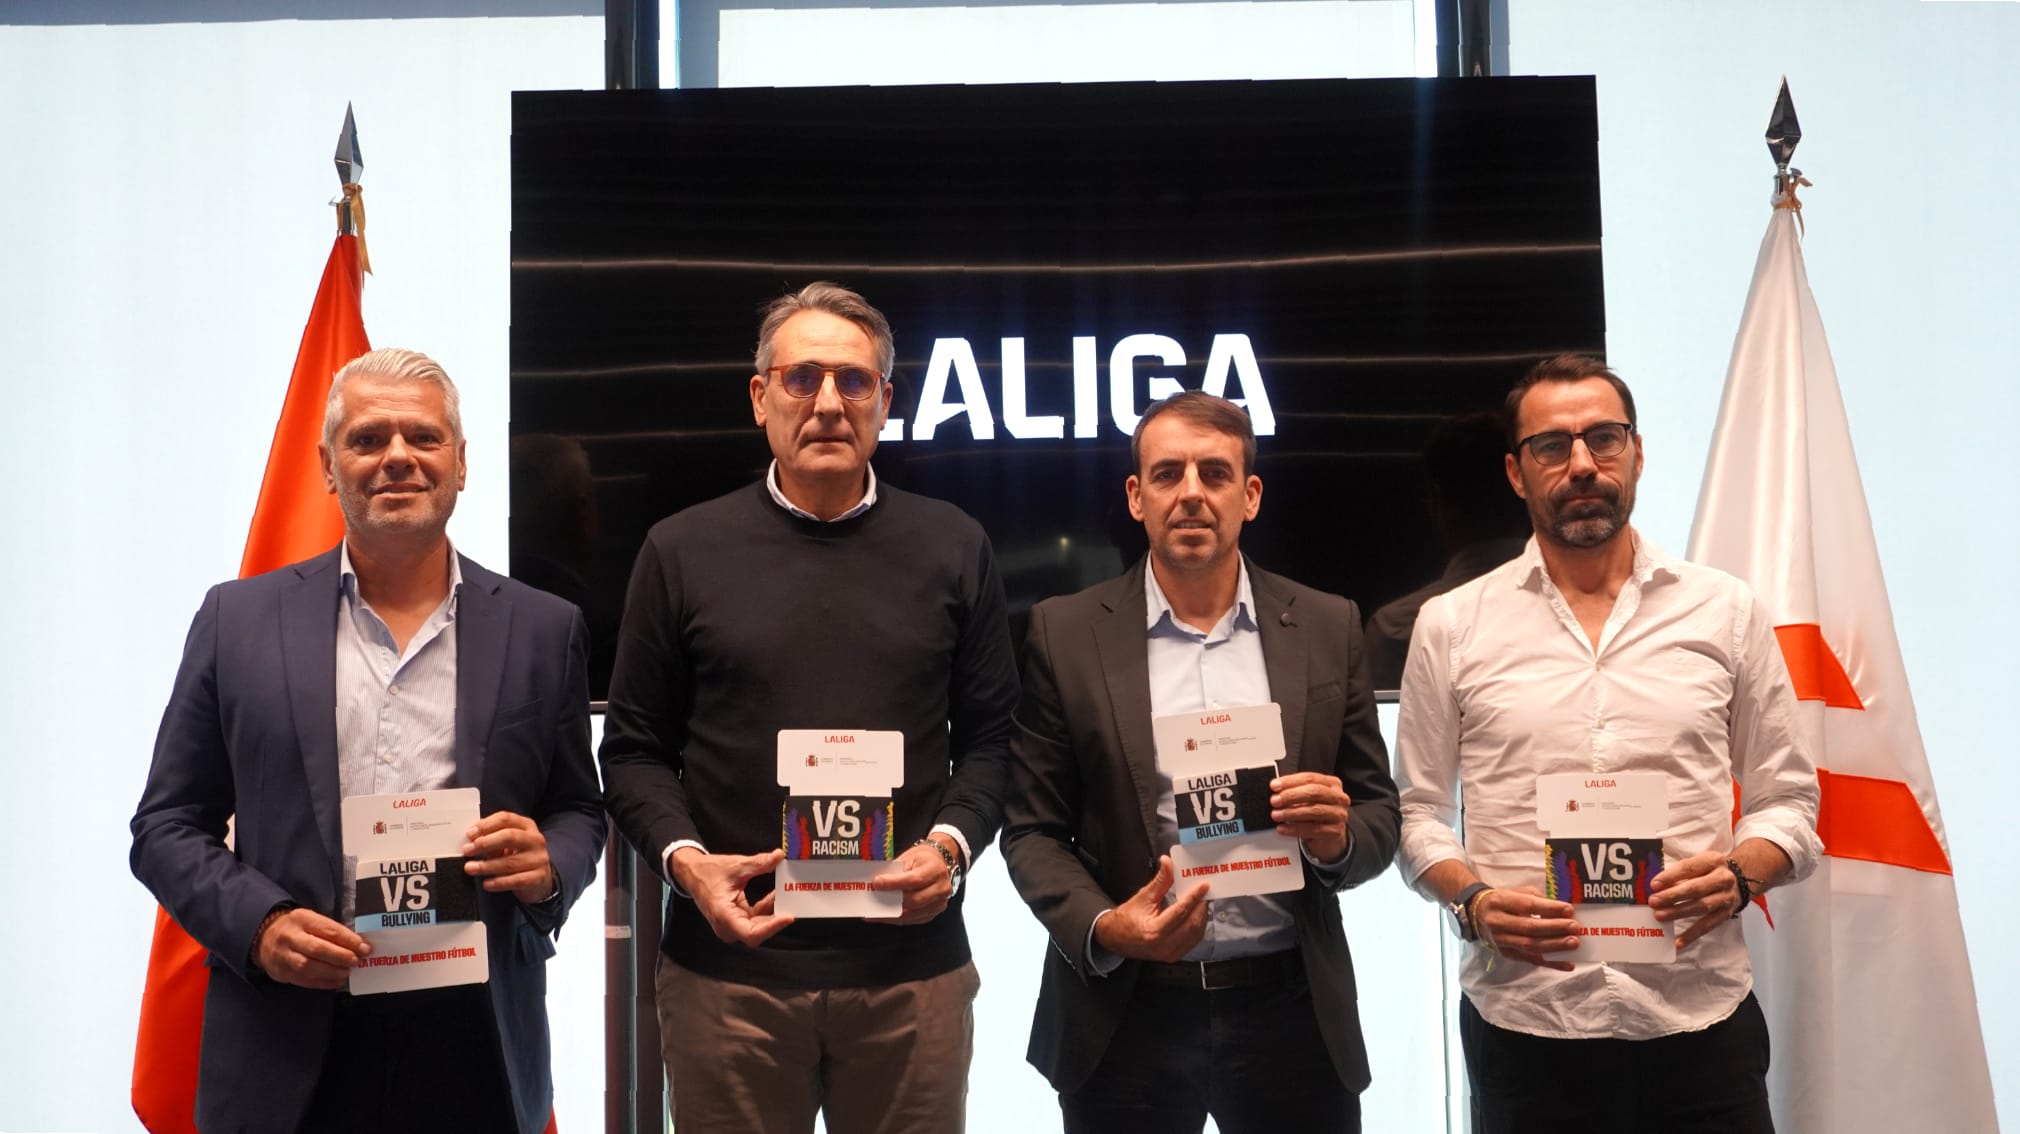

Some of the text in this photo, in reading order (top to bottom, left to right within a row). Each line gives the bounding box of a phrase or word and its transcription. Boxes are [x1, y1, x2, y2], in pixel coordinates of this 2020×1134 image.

[1200, 714, 1231, 725] LALIGA
[824, 735, 855, 743] LALIGA
[1188, 773, 1232, 791] LALIGA
[1584, 780, 1617, 788] LALIGA
[392, 798, 426, 809] LALIGA
[1189, 787, 1236, 825] VS
[812, 799, 860, 838] VS
[1195, 821, 1239, 840] BULLYING
[812, 840, 859, 855] RACISM
[380, 860, 429, 875] LALIGA
[1181, 856, 1291, 878] LA FUERZA DE NUESTRO FÚTBOL
[1580, 842, 1634, 880] VS
[380, 874, 430, 912] VS
[784, 883, 794, 892] LA
[795, 882, 821, 892] FUERZA
[823, 882, 832, 891] DE
[834, 881, 865, 891] NUESTRO
[1583, 883, 1633, 899] RACISM
[381, 911, 430, 927] BULLYING
[1590, 927, 1599, 936] DE
[1601, 927, 1635, 937] NUESTRO
[1636, 926, 1664, 937] FÚTBOL
[369, 955, 398, 967] FUERZA
[400, 954, 409, 964] DE
[411, 950, 446, 963] NUESTRO
[447, 947, 476, 959] FÚTBOL
